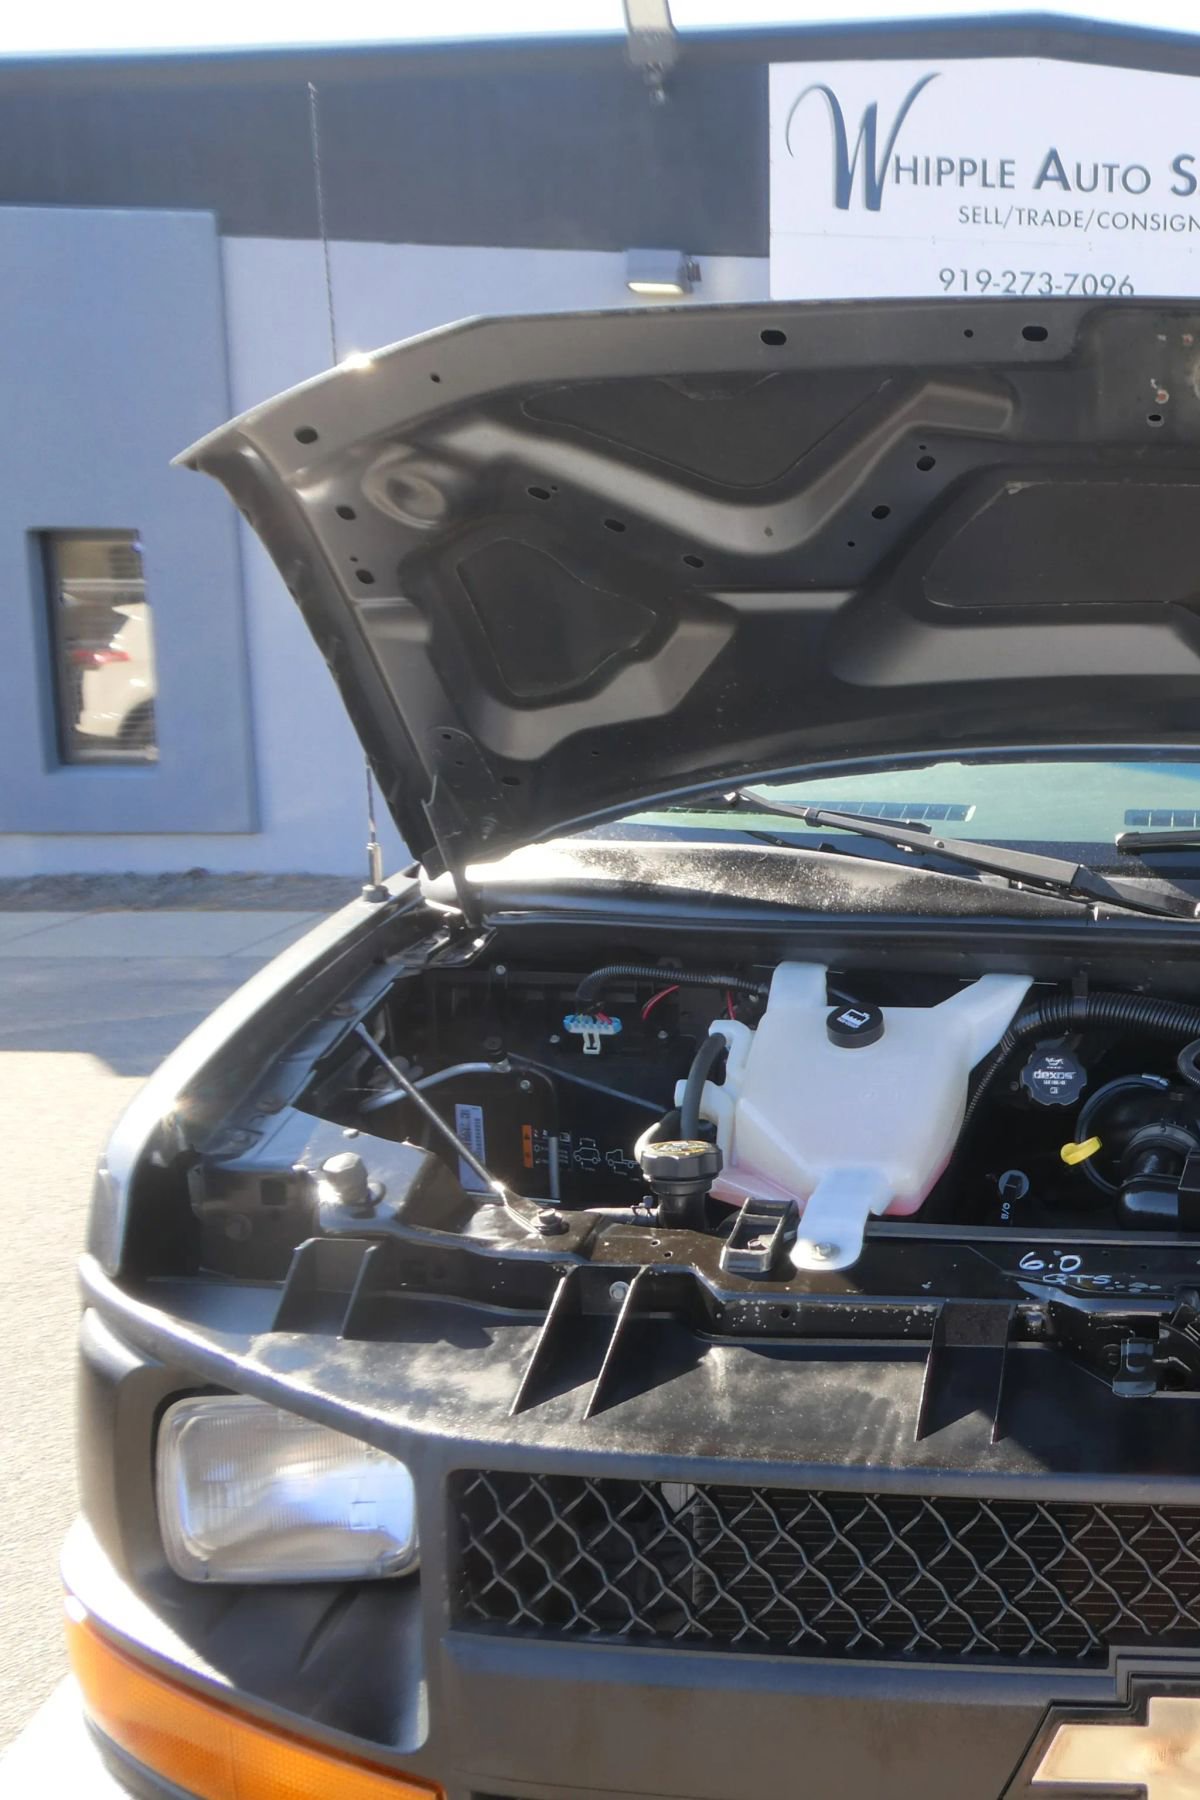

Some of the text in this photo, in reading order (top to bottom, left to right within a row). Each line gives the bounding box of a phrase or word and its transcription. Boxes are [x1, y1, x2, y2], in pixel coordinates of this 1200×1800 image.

[786, 72, 1015, 211] WHIPPLE
[1033, 147, 1151, 195] AUTO
[938, 268, 1135, 296] 919-273-7096
[1033, 1069, 1076, 1080] dexos
[1019, 1252, 1081, 1272] 6.0
